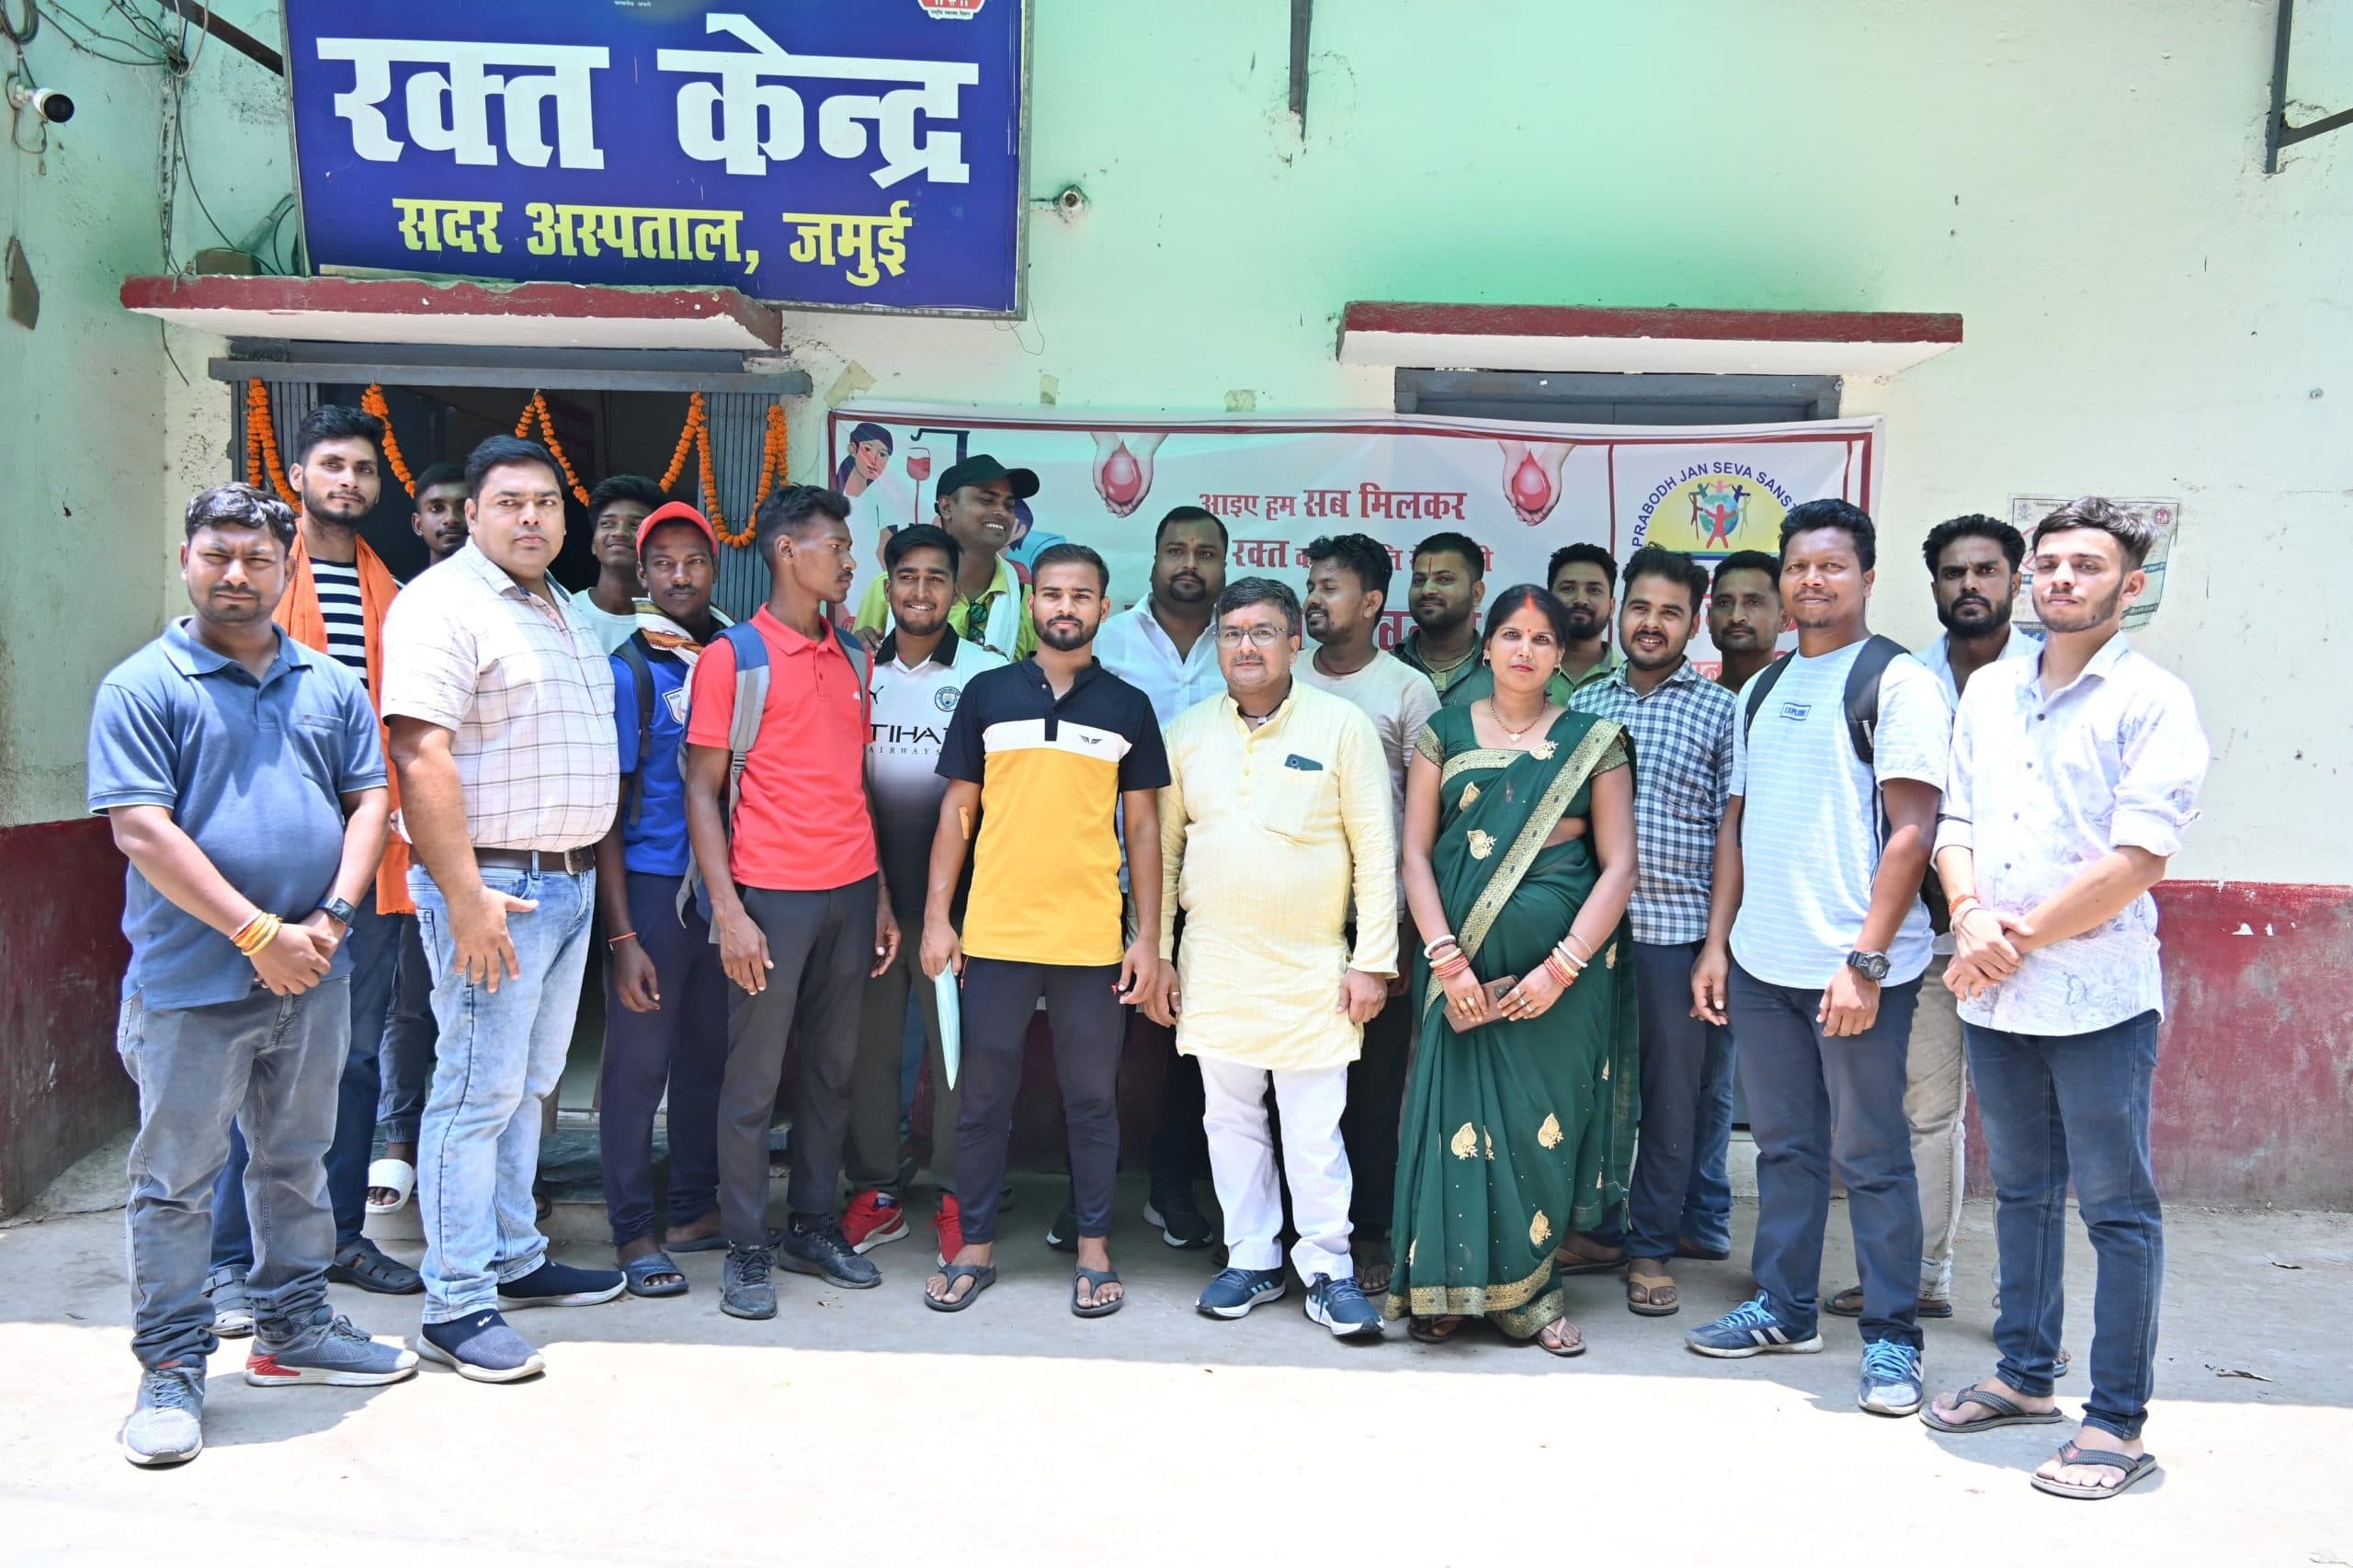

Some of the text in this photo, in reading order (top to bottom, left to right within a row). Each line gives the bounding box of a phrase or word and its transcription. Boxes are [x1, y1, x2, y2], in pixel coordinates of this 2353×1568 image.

[316, 13, 980, 189] रक्त केन्द्र
[392, 198, 914, 287] सदर अस्पताल, जमुई
[1199, 482, 1468, 520] आइए हम सब मिलकर
[1631, 476, 1677, 547] PRABODH
[1680, 462, 1709, 483] JAN
[1713, 461, 1753, 479] SEVA
[1233, 540, 1290, 568] रक्त
[870, 723, 949, 744] TIHA
